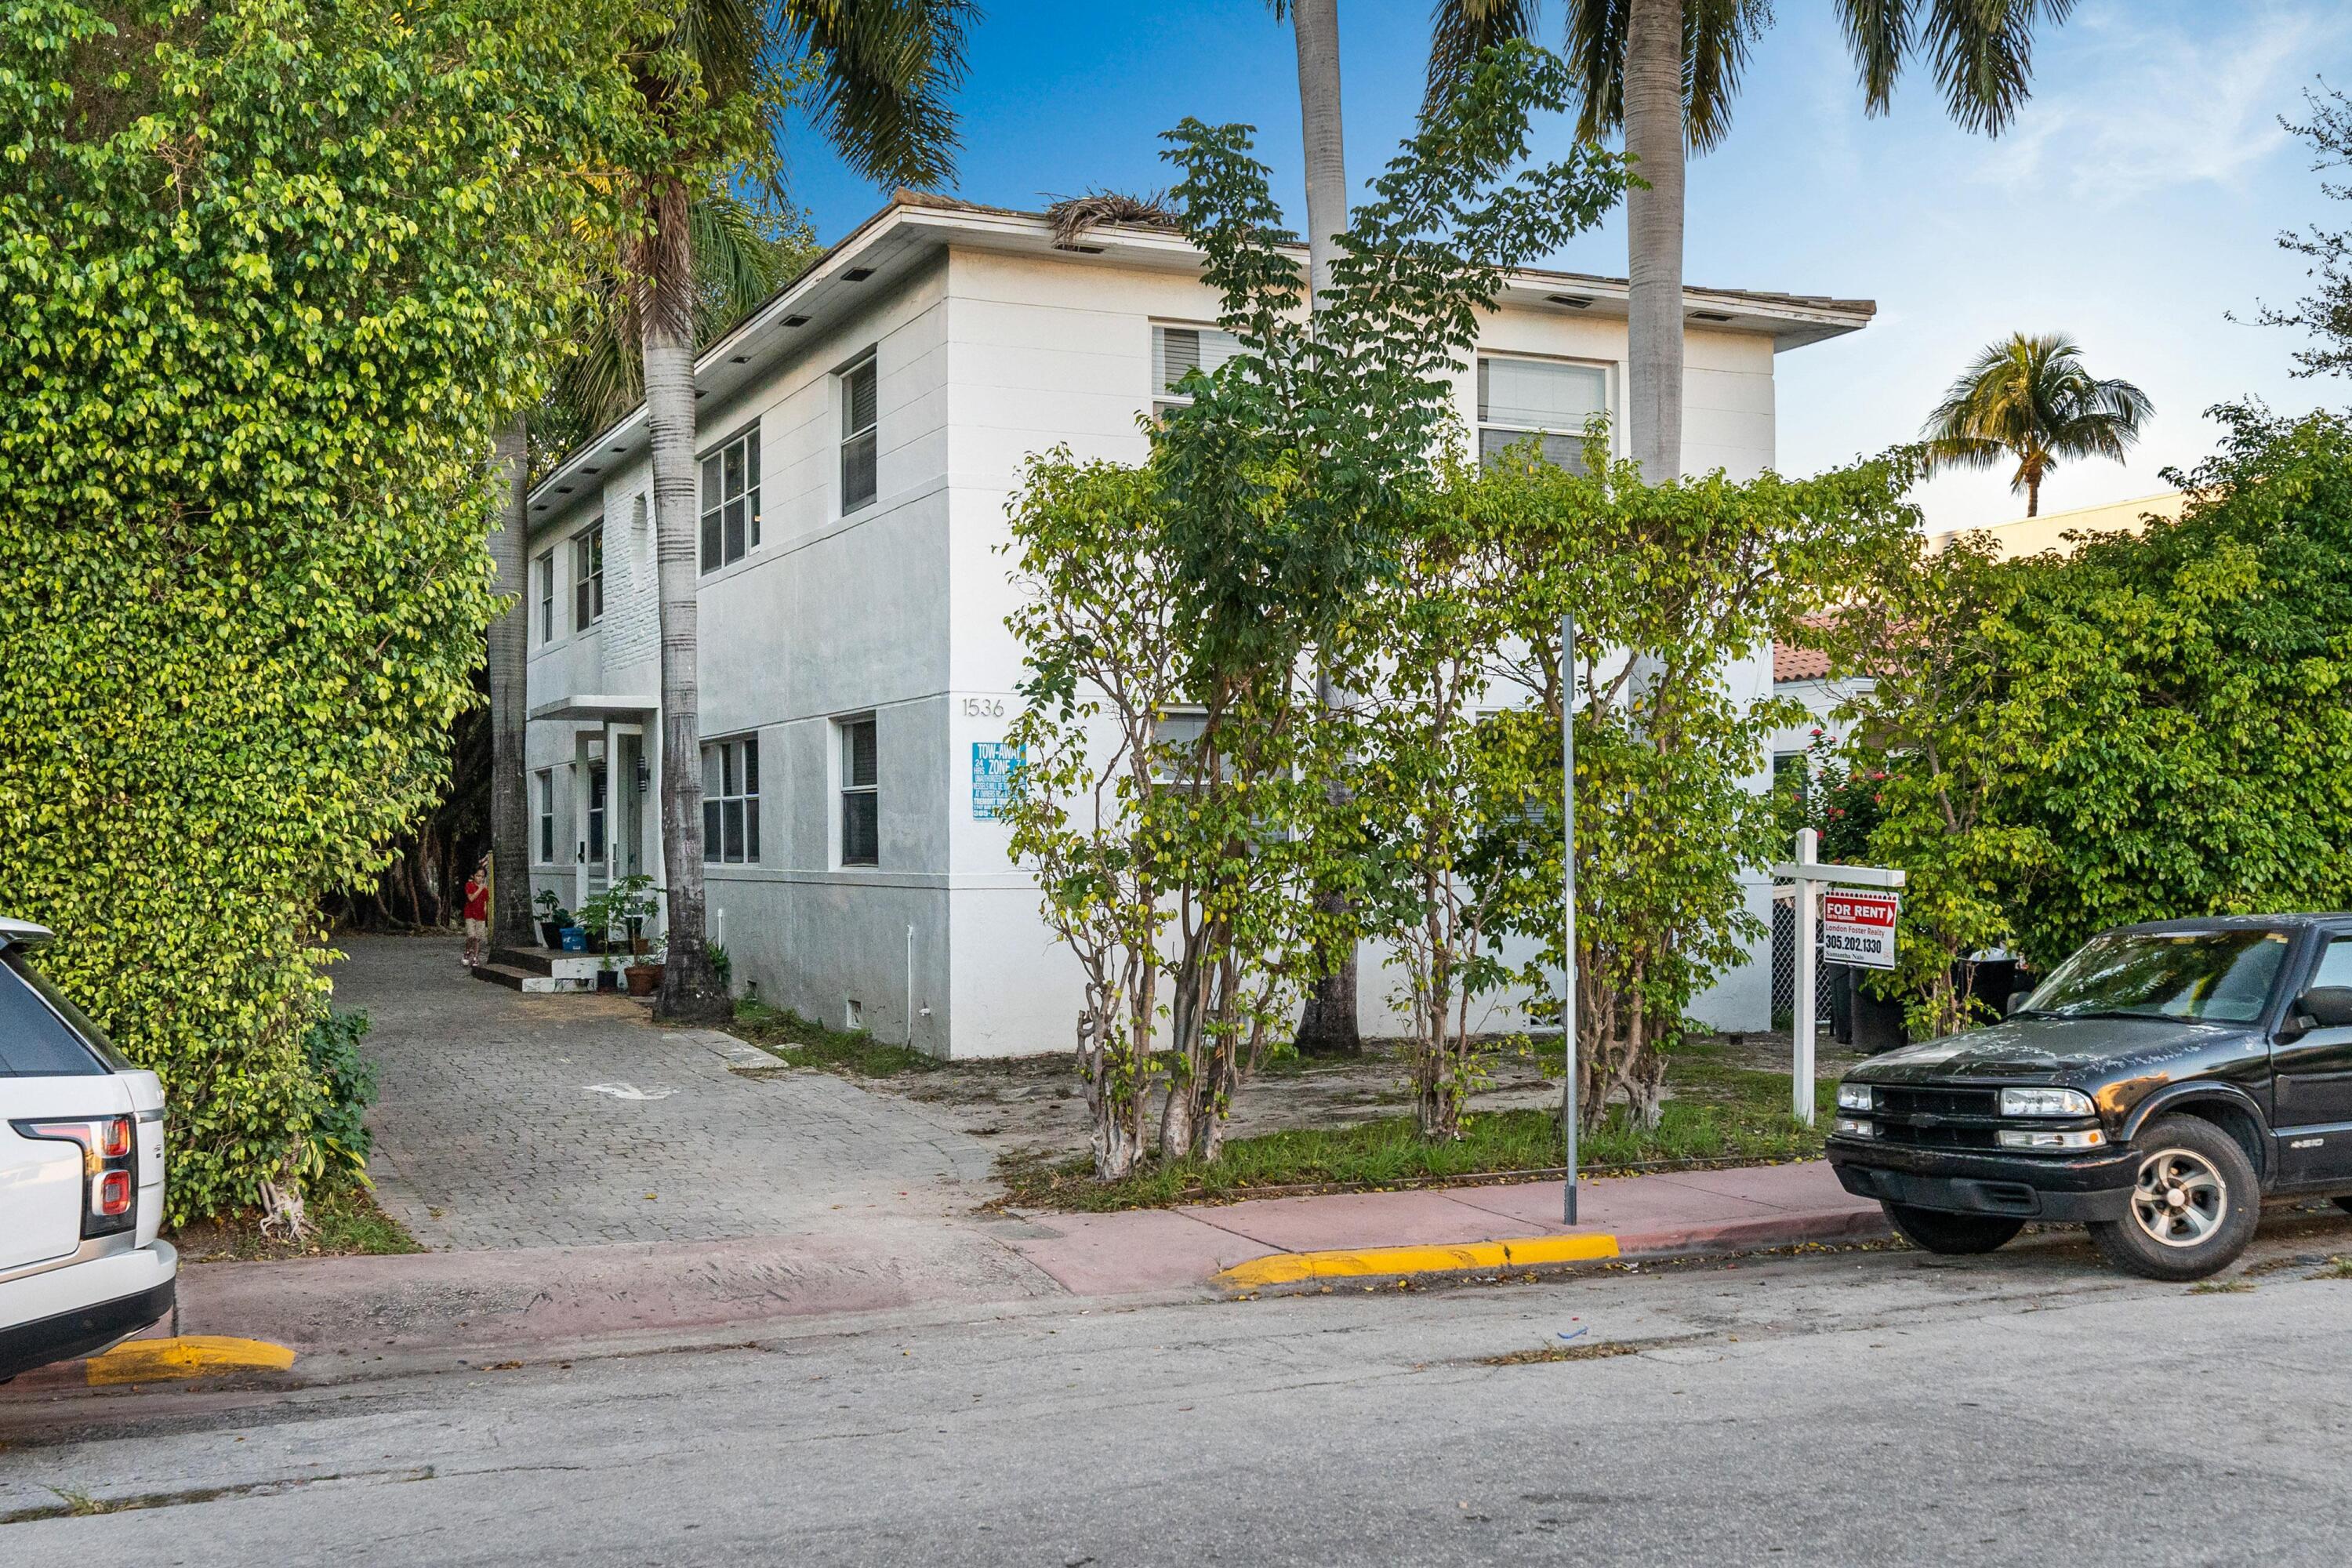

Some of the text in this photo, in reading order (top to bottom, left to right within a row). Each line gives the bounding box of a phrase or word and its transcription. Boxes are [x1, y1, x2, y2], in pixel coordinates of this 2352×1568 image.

[962, 699, 1004, 717] 1536
[977, 744, 1021, 760] TOW-AWAY
[989, 760, 1011, 775] ZONE
[1827, 903, 1851, 916] FOR
[1854, 906, 1886, 919] RENT
[1825, 924, 1847, 933] London
[1867, 927, 1886, 938] Realty
[1826, 935, 1882, 953] 305.202.1330
